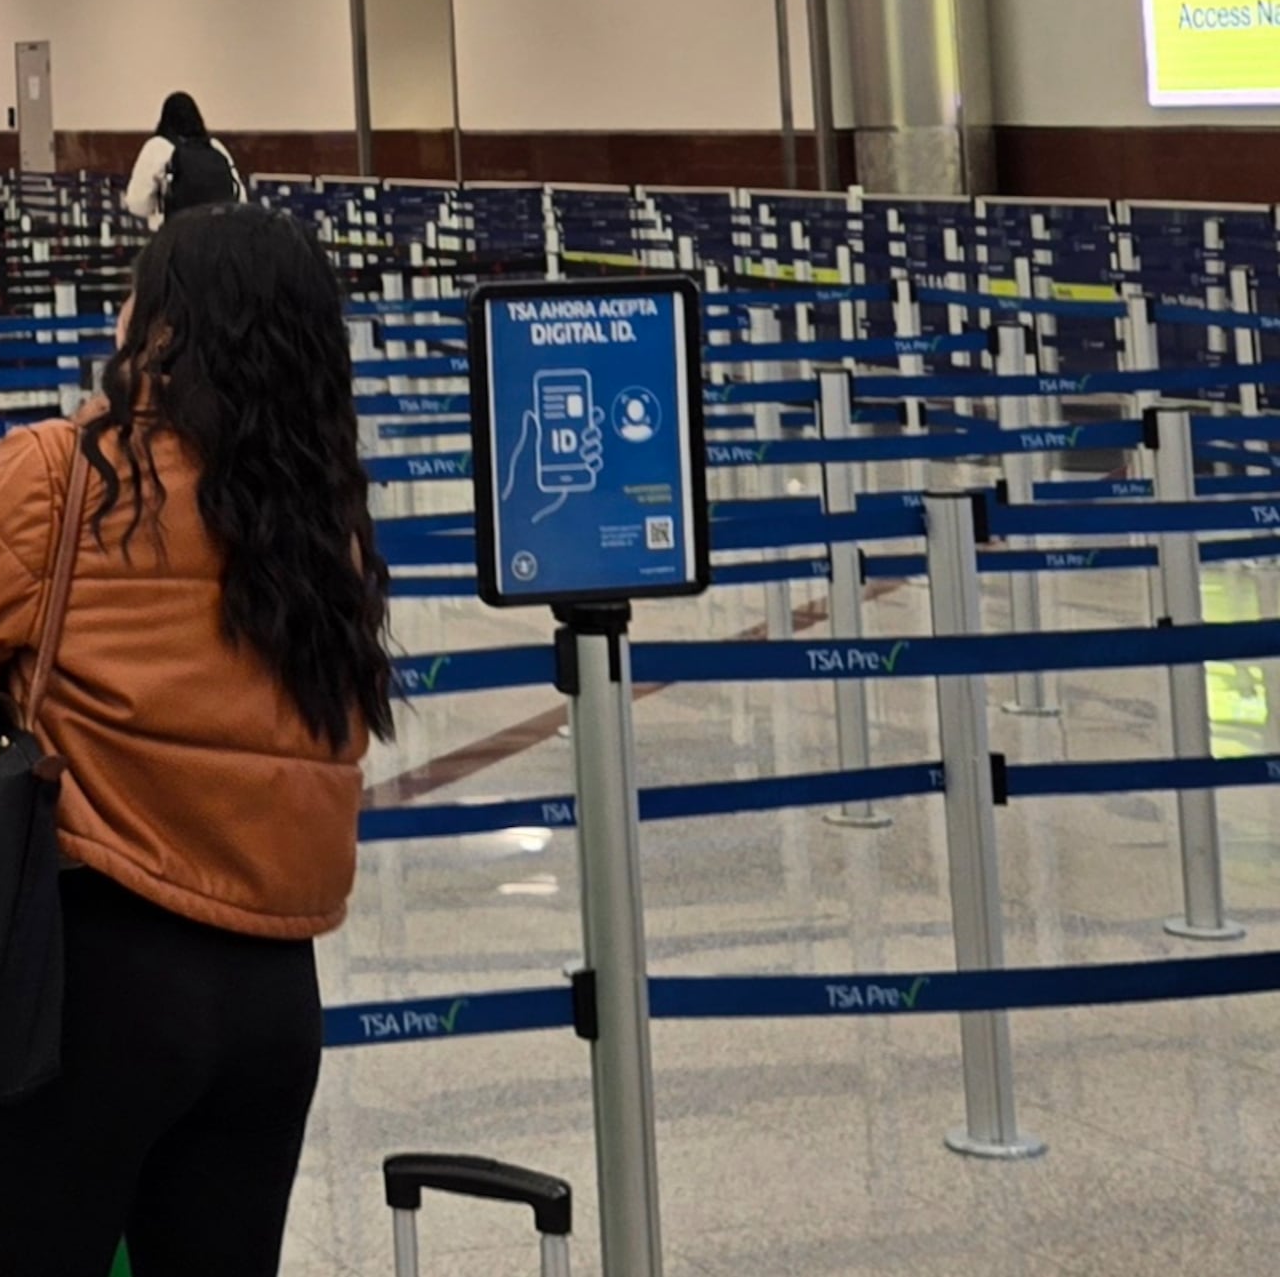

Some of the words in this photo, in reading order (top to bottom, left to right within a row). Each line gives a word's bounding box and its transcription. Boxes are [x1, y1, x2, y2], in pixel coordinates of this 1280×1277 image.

[1178, 1, 1252, 31] Access
[507, 301, 538, 321] TSA
[540, 300, 597, 320] AHORA
[599, 298, 658, 318] ACEPTA
[530, 321, 609, 346] DIGITAL
[551, 428, 578, 454] ID
[707, 445, 731, 461] TSA
[732, 444, 756, 460] Pre
[1251, 506, 1280, 523] TSA
[807, 649, 844, 671] TSA
[847, 647, 880, 669] Pre
[542, 803, 571, 823] TSA
[825, 985, 864, 1008] TSA
[867, 983, 900, 1007] Pre
[360, 1013, 401, 1036] TSA
[403, 1010, 440, 1032] Pre
